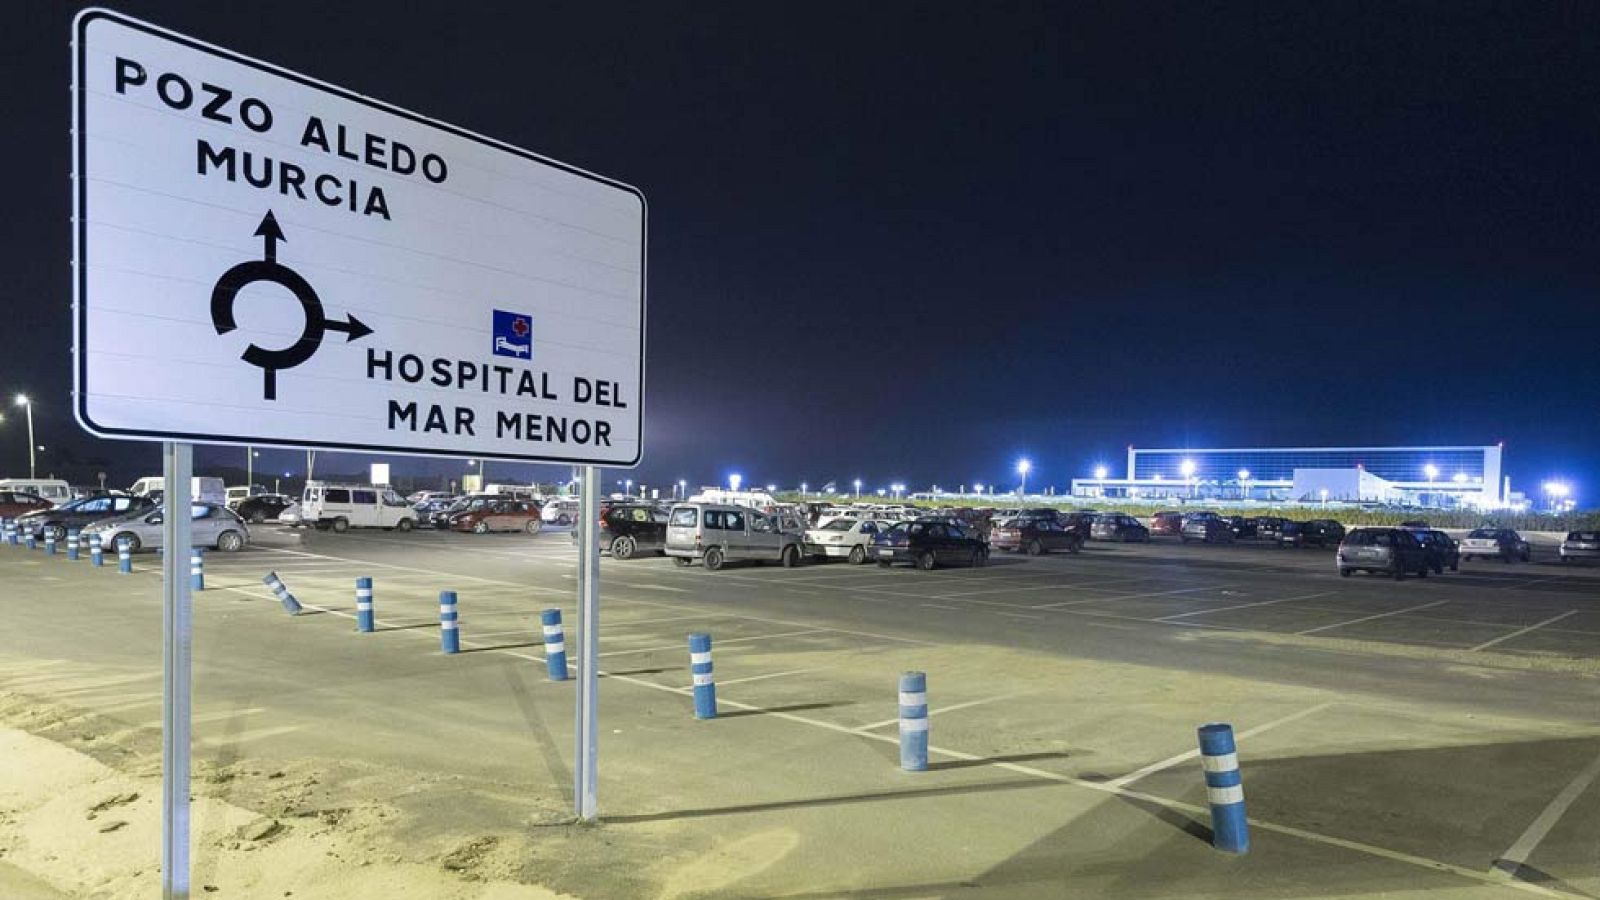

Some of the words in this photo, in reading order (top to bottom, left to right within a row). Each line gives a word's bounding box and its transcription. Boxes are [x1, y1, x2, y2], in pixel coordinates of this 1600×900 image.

[115, 56, 274, 133] POZO
[299, 115, 448, 184] ALEDO
[197, 138, 392, 221] MURCIA
[366, 347, 558, 401] HOSPITAL
[573, 376, 628, 409] DEL
[387, 399, 476, 437] MAR
[496, 410, 612, 447] MENOR
